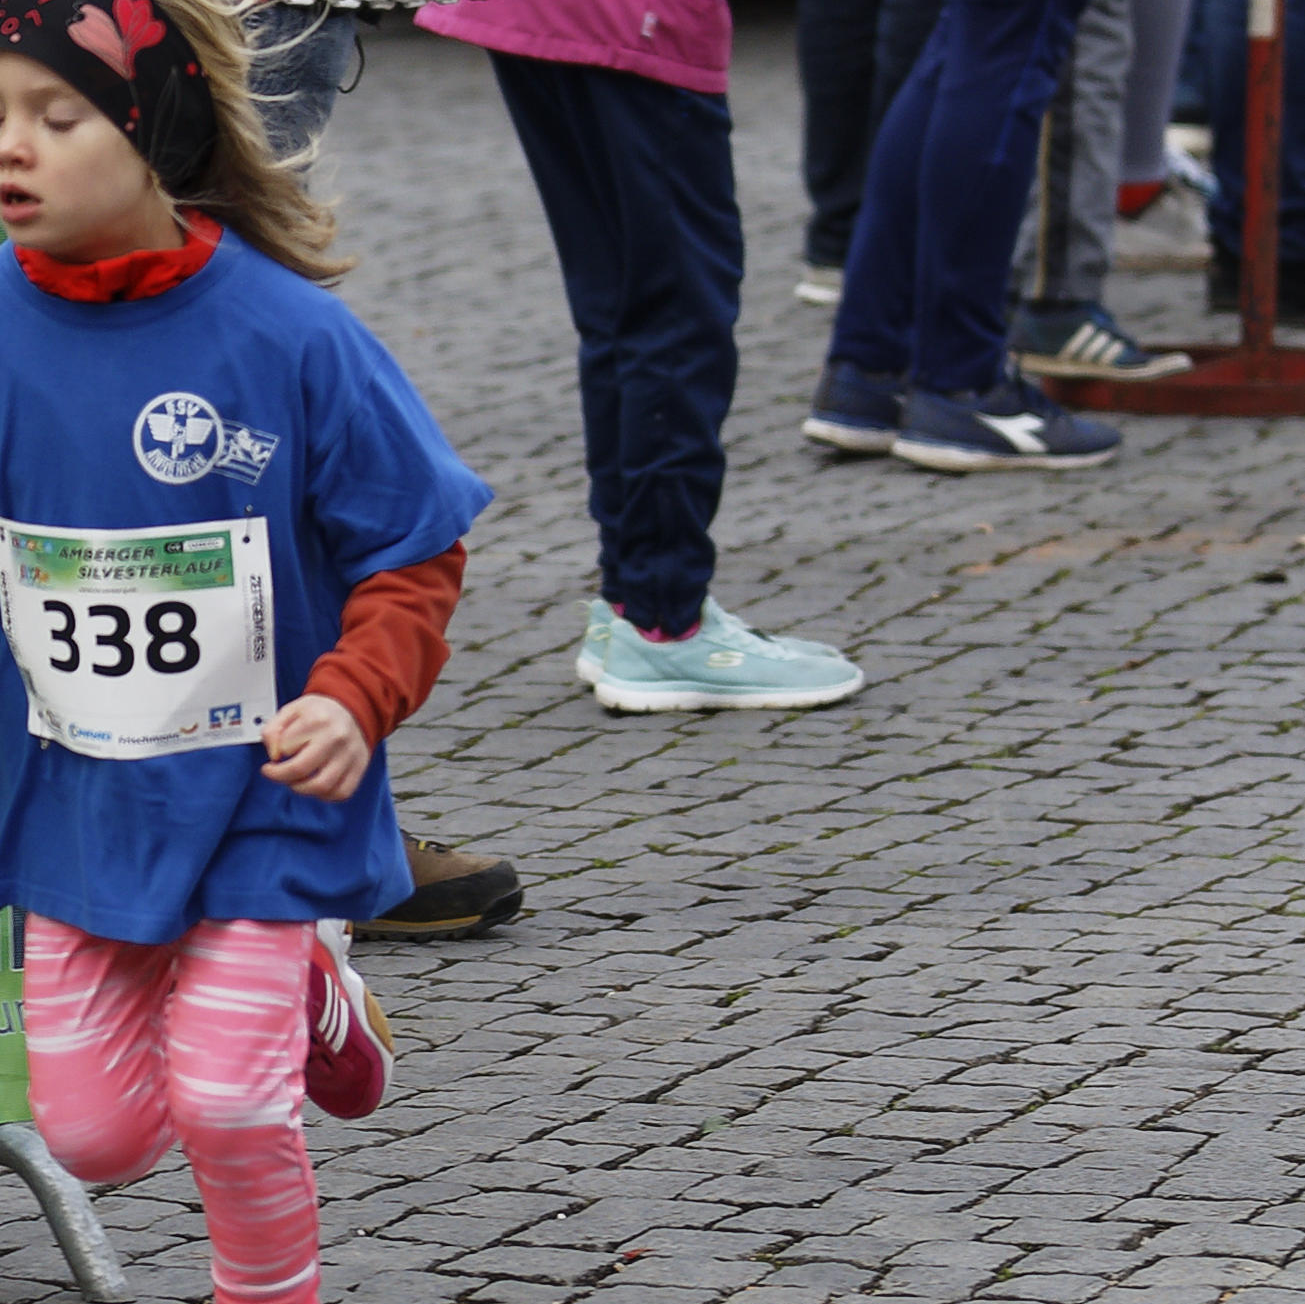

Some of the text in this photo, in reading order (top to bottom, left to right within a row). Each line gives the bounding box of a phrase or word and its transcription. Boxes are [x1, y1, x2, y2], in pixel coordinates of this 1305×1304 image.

[57, 545, 156, 563] AMBERGER
[77, 557, 226, 581] SILVESTERLAUF
[43, 599, 201, 678] 338
